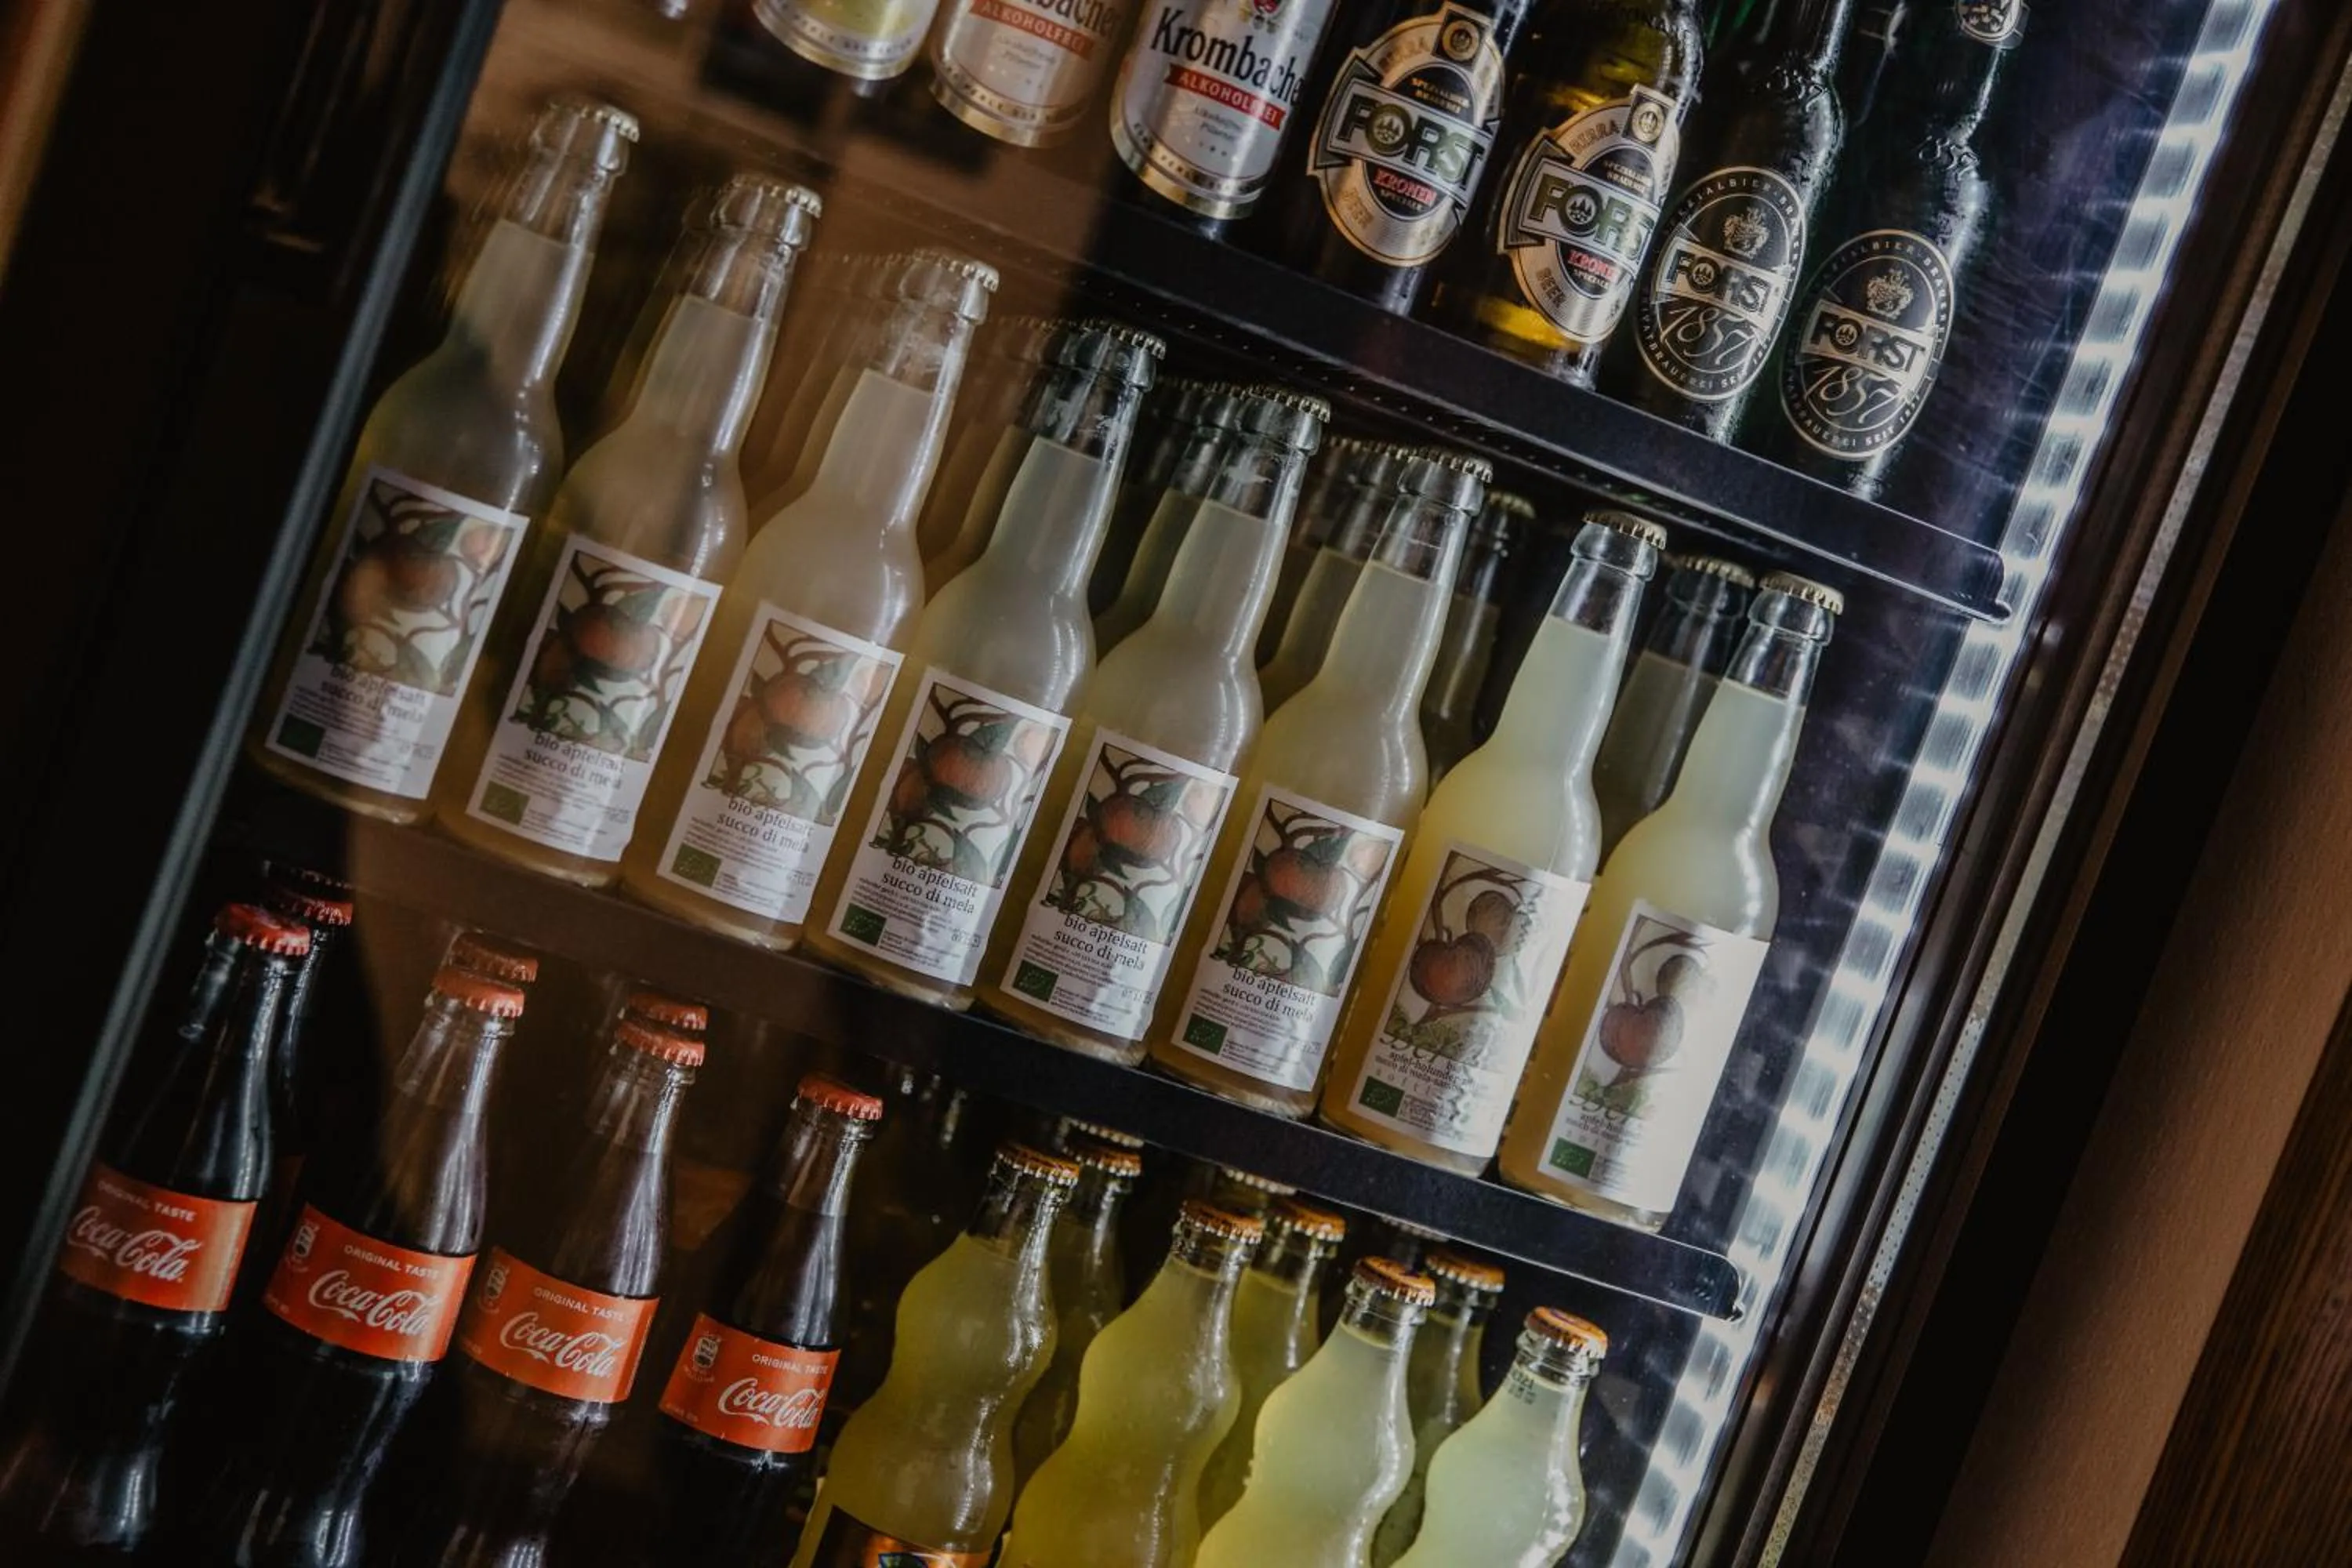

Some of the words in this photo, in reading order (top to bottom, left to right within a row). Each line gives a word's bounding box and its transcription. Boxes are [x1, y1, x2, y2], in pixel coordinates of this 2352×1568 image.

[1178, 71, 1276, 123] ALKOHOLEI
[1336, 93, 1485, 191] FORST
[1660, 305, 1758, 367] 1857
[1809, 311, 1926, 373] FORST
[1803, 365, 1902, 425] 1857
[535, 732, 560, 751] bio
[525, 748, 568, 772] succo
[571, 765, 586, 779] di
[728, 797, 752, 816] bio
[717, 813, 760, 838] succo
[762, 827, 779, 843] di
[881, 873, 923, 896] succo
[925, 886, 942, 903] di
[942, 895, 976, 914] mela
[891, 855, 916, 876] bio
[917, 867, 979, 898] apfelsaft
[1054, 930, 1094, 954] succo
[1097, 944, 1112, 961] di
[1113, 953, 1145, 971] mela
[1063, 913, 1087, 933] bio
[1089, 926, 1148, 955] apfelsaft
[1223, 982, 1262, 1007] succo
[1265, 996, 1281, 1013] di
[1232, 967, 1256, 985] bio
[1257, 978, 1317, 1007] apfelsaft
[154, 1202, 196, 1221] TASTE
[67, 1205, 203, 1282] Coca-Cola
[343, 1244, 401, 1272] ORIGINAL
[405, 1264, 440, 1279] TASTE
[308, 1269, 444, 1337] Coca-Cola
[533, 1286, 589, 1313] ORIGINAL
[592, 1306, 626, 1322] TASTE
[499, 1311, 627, 1377] Coca-Cola
[751, 1353, 802, 1373] ORIGINAL
[717, 1377, 827, 1429] Coca-Cola
